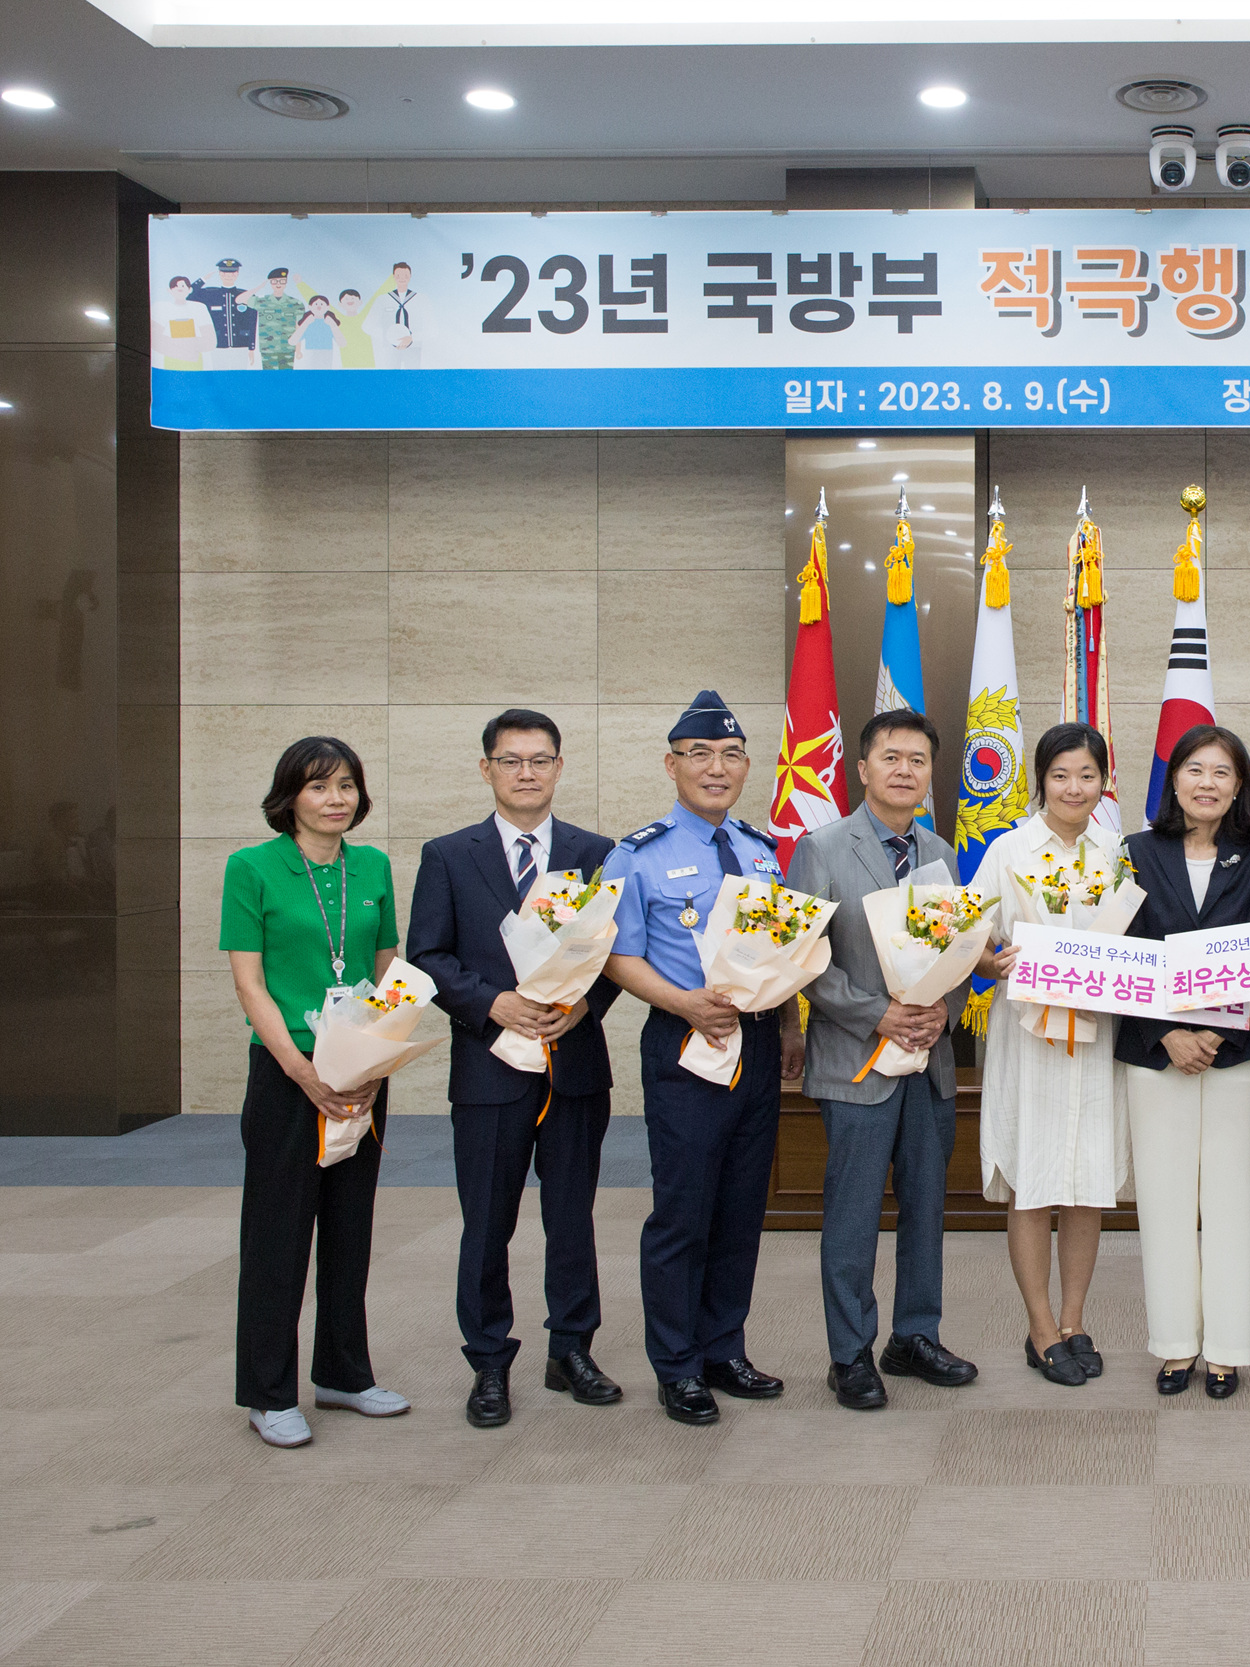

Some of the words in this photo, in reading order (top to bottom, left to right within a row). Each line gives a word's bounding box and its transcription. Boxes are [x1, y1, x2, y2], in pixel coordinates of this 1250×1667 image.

[703, 252, 942, 334] 국방부
[784, 379, 848, 414] 일자
[878, 381, 971, 412] 2023.
[982, 381, 1012, 411] 8.
[1024, 377, 1111, 415] 9.(수)
[1054, 941, 1102, 960] 2023년
[1105, 947, 1158, 967] 우수사례
[1205, 936, 1250, 955] 2023년
[1015, 961, 1107, 997] 최우수상
[1112, 973, 1156, 1004] 상금
